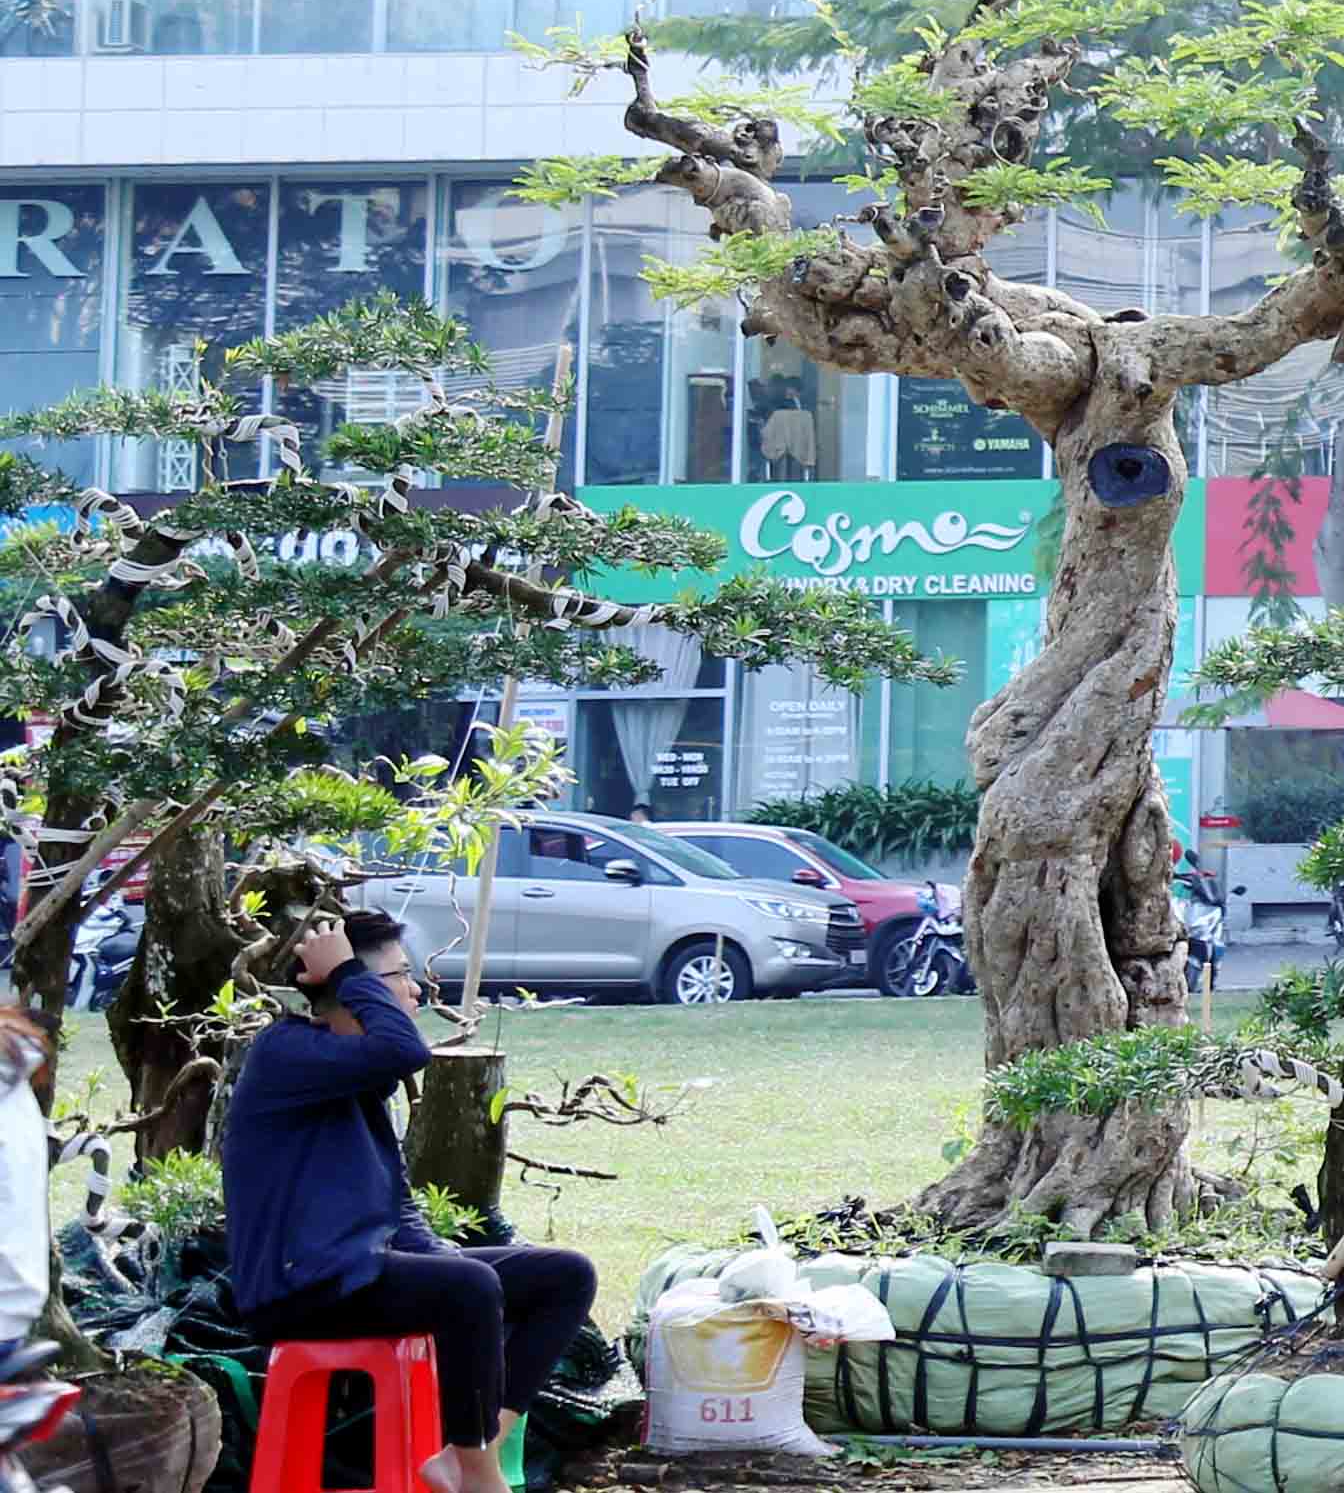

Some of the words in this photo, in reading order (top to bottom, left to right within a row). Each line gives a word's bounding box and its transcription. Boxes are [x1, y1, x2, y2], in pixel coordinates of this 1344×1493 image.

[988, 438, 1030, 450] YAMAHA
[740, 491, 1030, 575] Cosmo
[874, 575, 917, 594] DRY
[924, 574, 1035, 594] CLEANING
[809, 699, 846, 712] DAILY
[701, 1398, 755, 1423] 611
